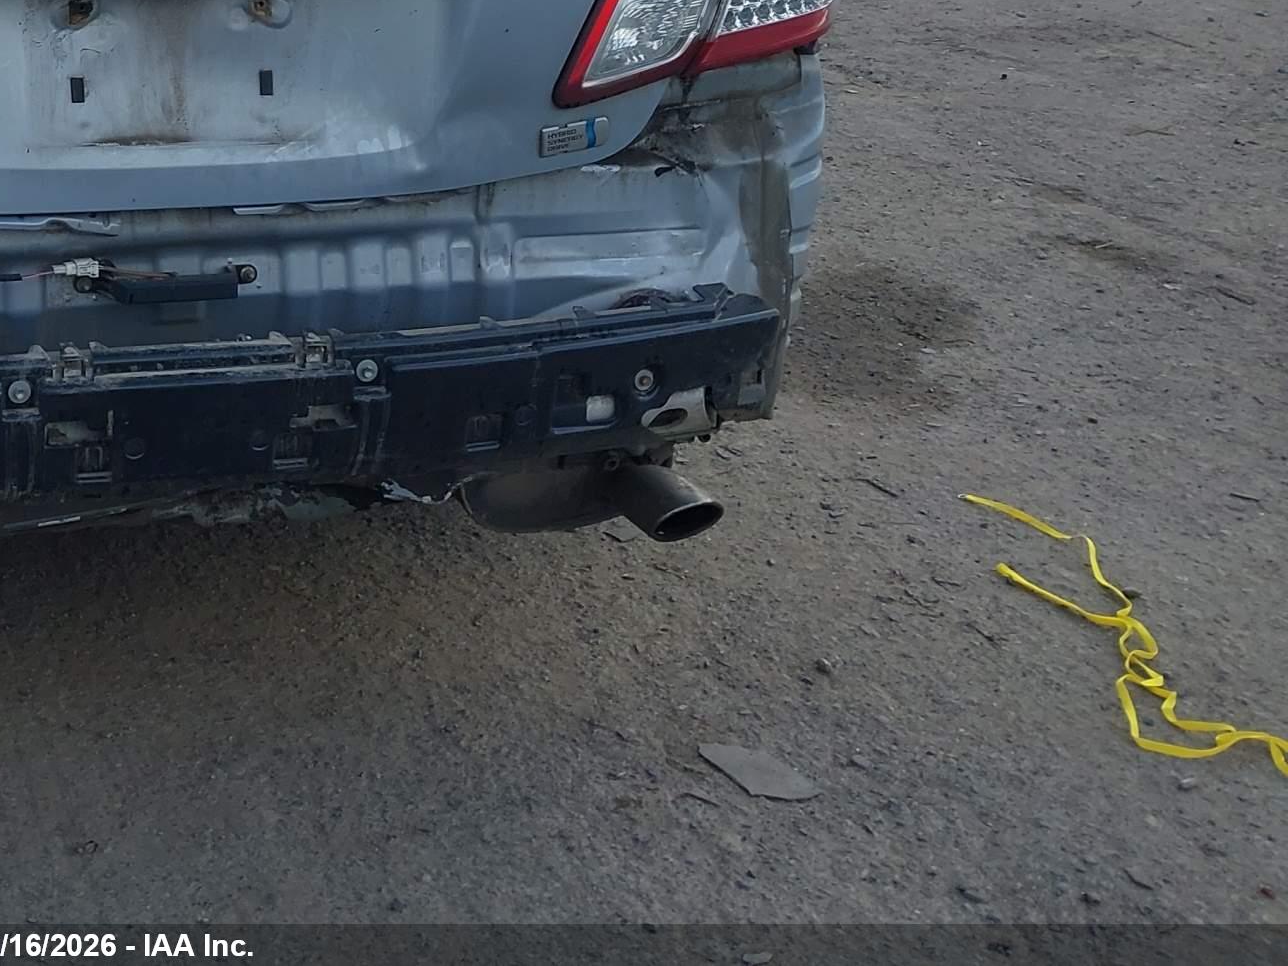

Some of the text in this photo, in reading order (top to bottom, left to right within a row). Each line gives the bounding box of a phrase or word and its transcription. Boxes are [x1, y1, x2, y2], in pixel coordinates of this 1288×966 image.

[547, 128, 577, 139] HYBRID
[547, 135, 583, 145] SYNERGY
[547, 143, 569, 152] DRIVE
